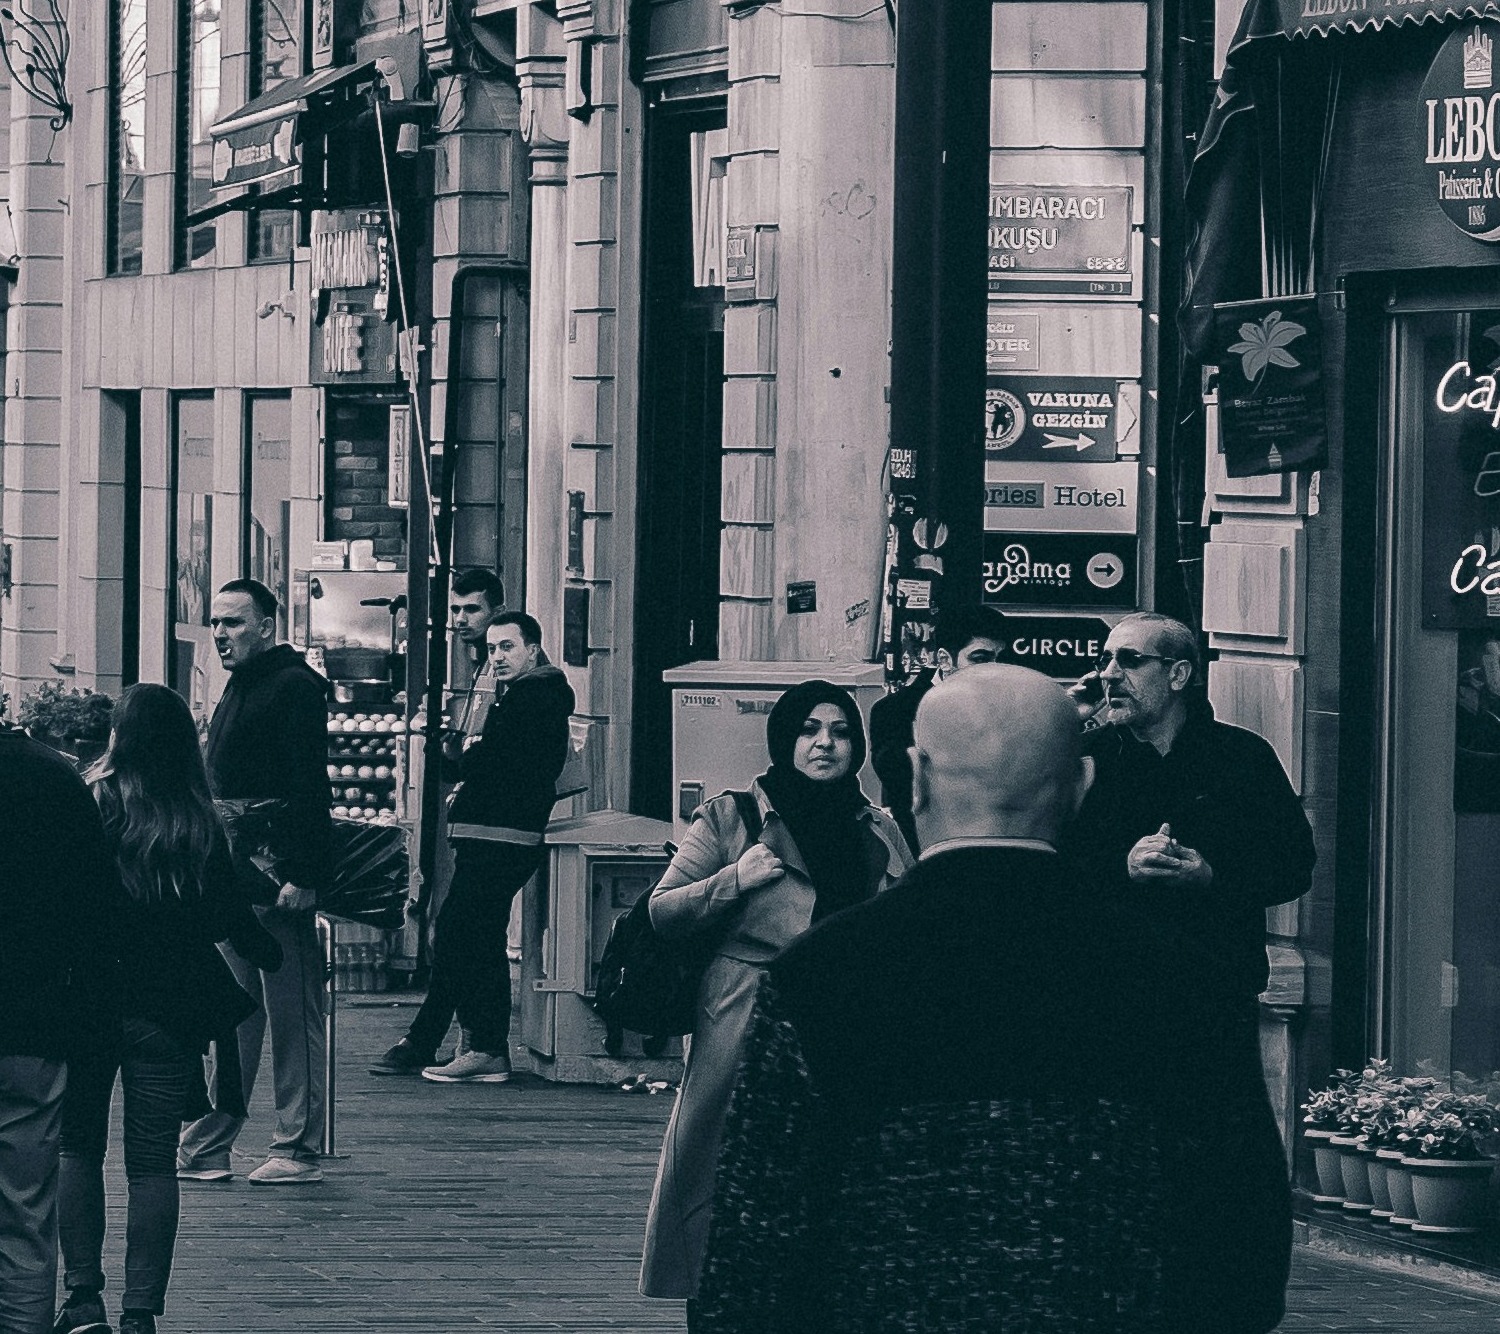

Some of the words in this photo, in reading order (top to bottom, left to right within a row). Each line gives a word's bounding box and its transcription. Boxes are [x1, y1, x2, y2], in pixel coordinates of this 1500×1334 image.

[1482, 168, 1494, 199] &
[1027, 392, 1114, 409] VARUNA
[1032, 410, 1109, 428] GEZGİN
[1053, 485, 1127, 508] Hotel
[1012, 638, 1100, 657] CIRCLE
